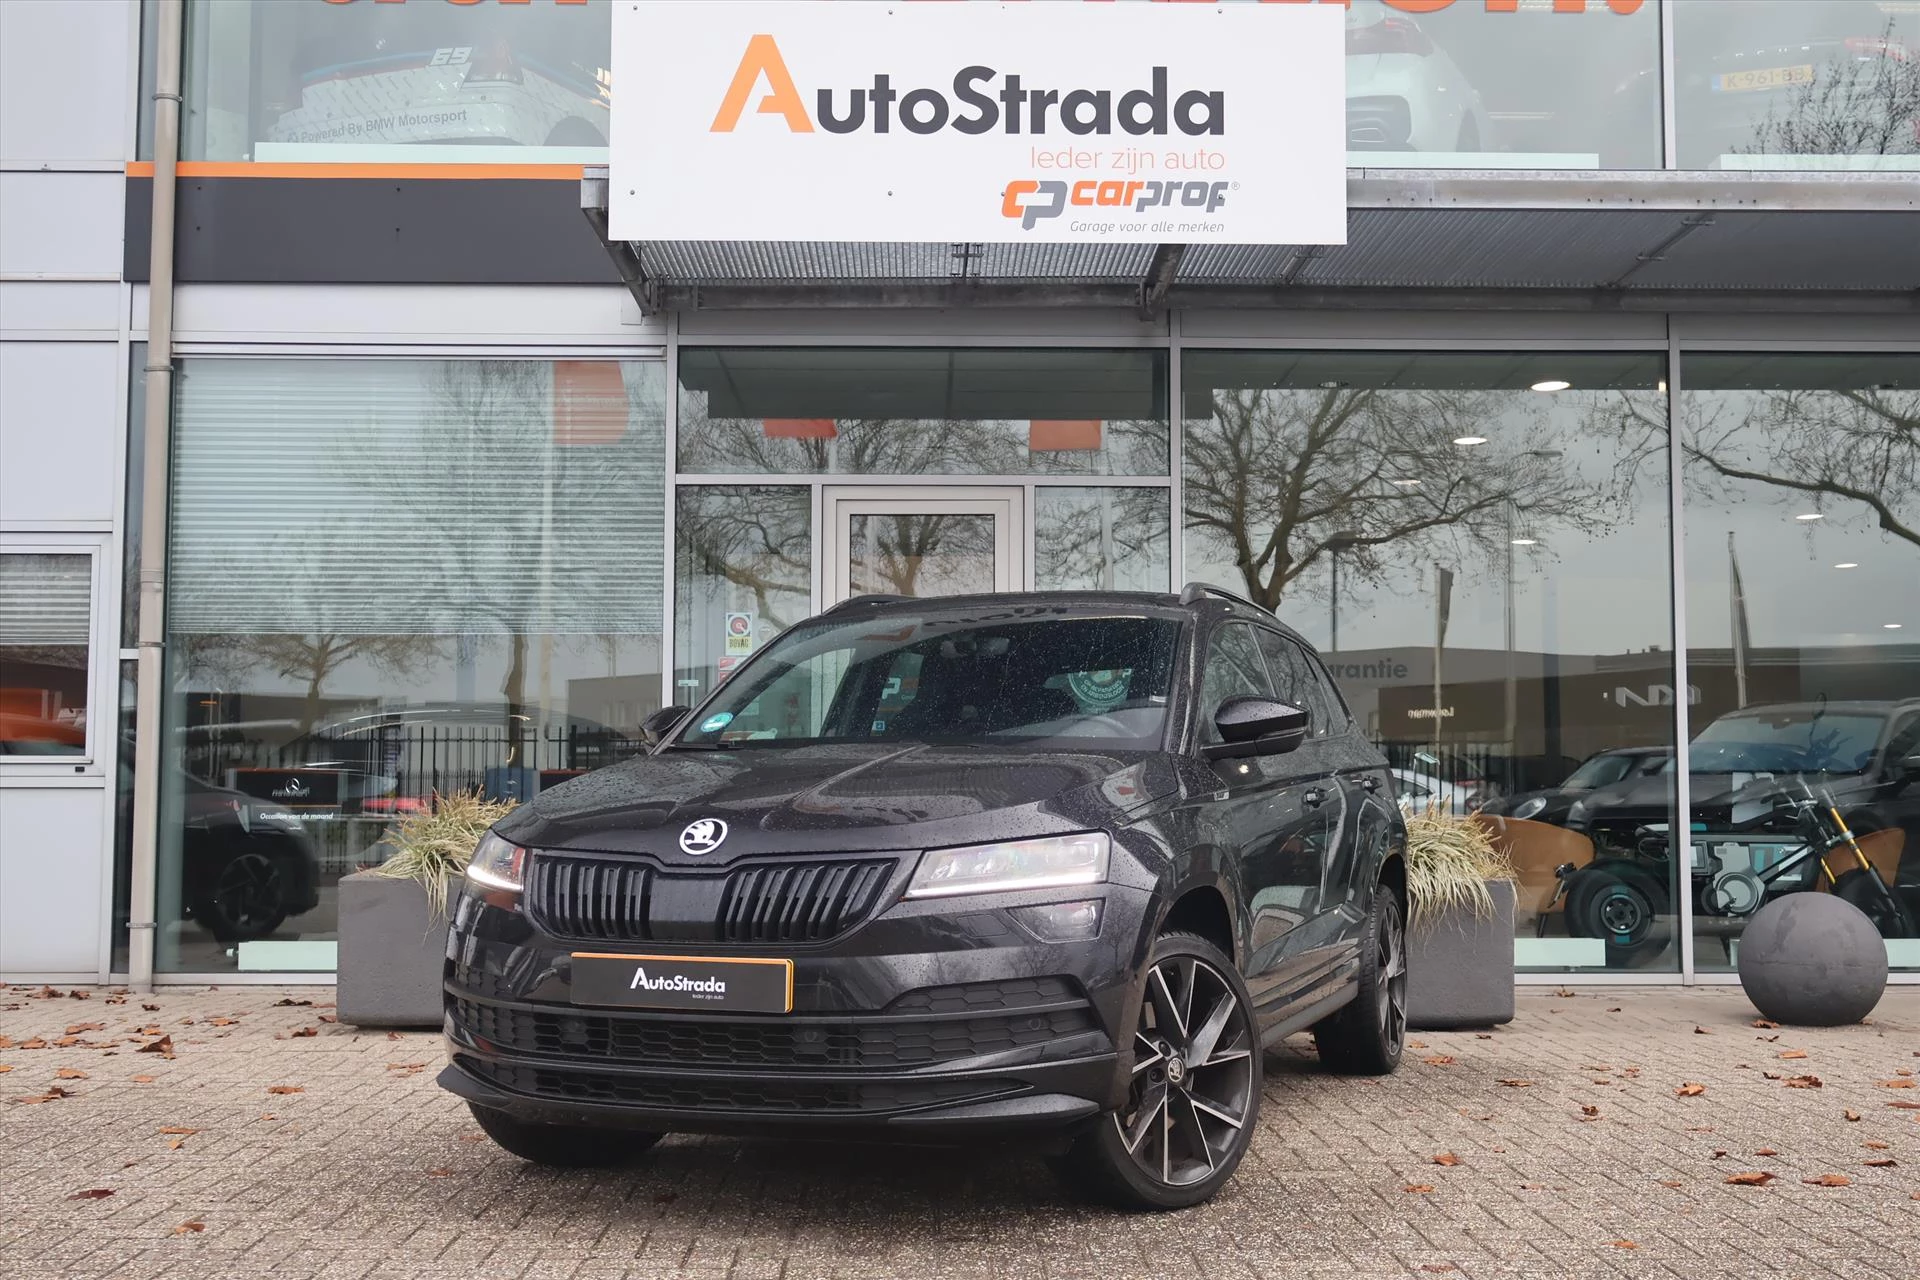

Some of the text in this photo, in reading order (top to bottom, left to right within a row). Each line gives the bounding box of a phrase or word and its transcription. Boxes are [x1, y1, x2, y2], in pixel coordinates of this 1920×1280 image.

[430, 47, 472, 66] 69
[708, 34, 1225, 136] AutoStrada
[301, 110, 467, 142] Powered By BMW Motorsport
[1031, 146, 1225, 175] Ieder zijn auto
[1070, 221, 1225, 235] Garage voor alle merken
[630, 967, 726, 993] AutoStrada
